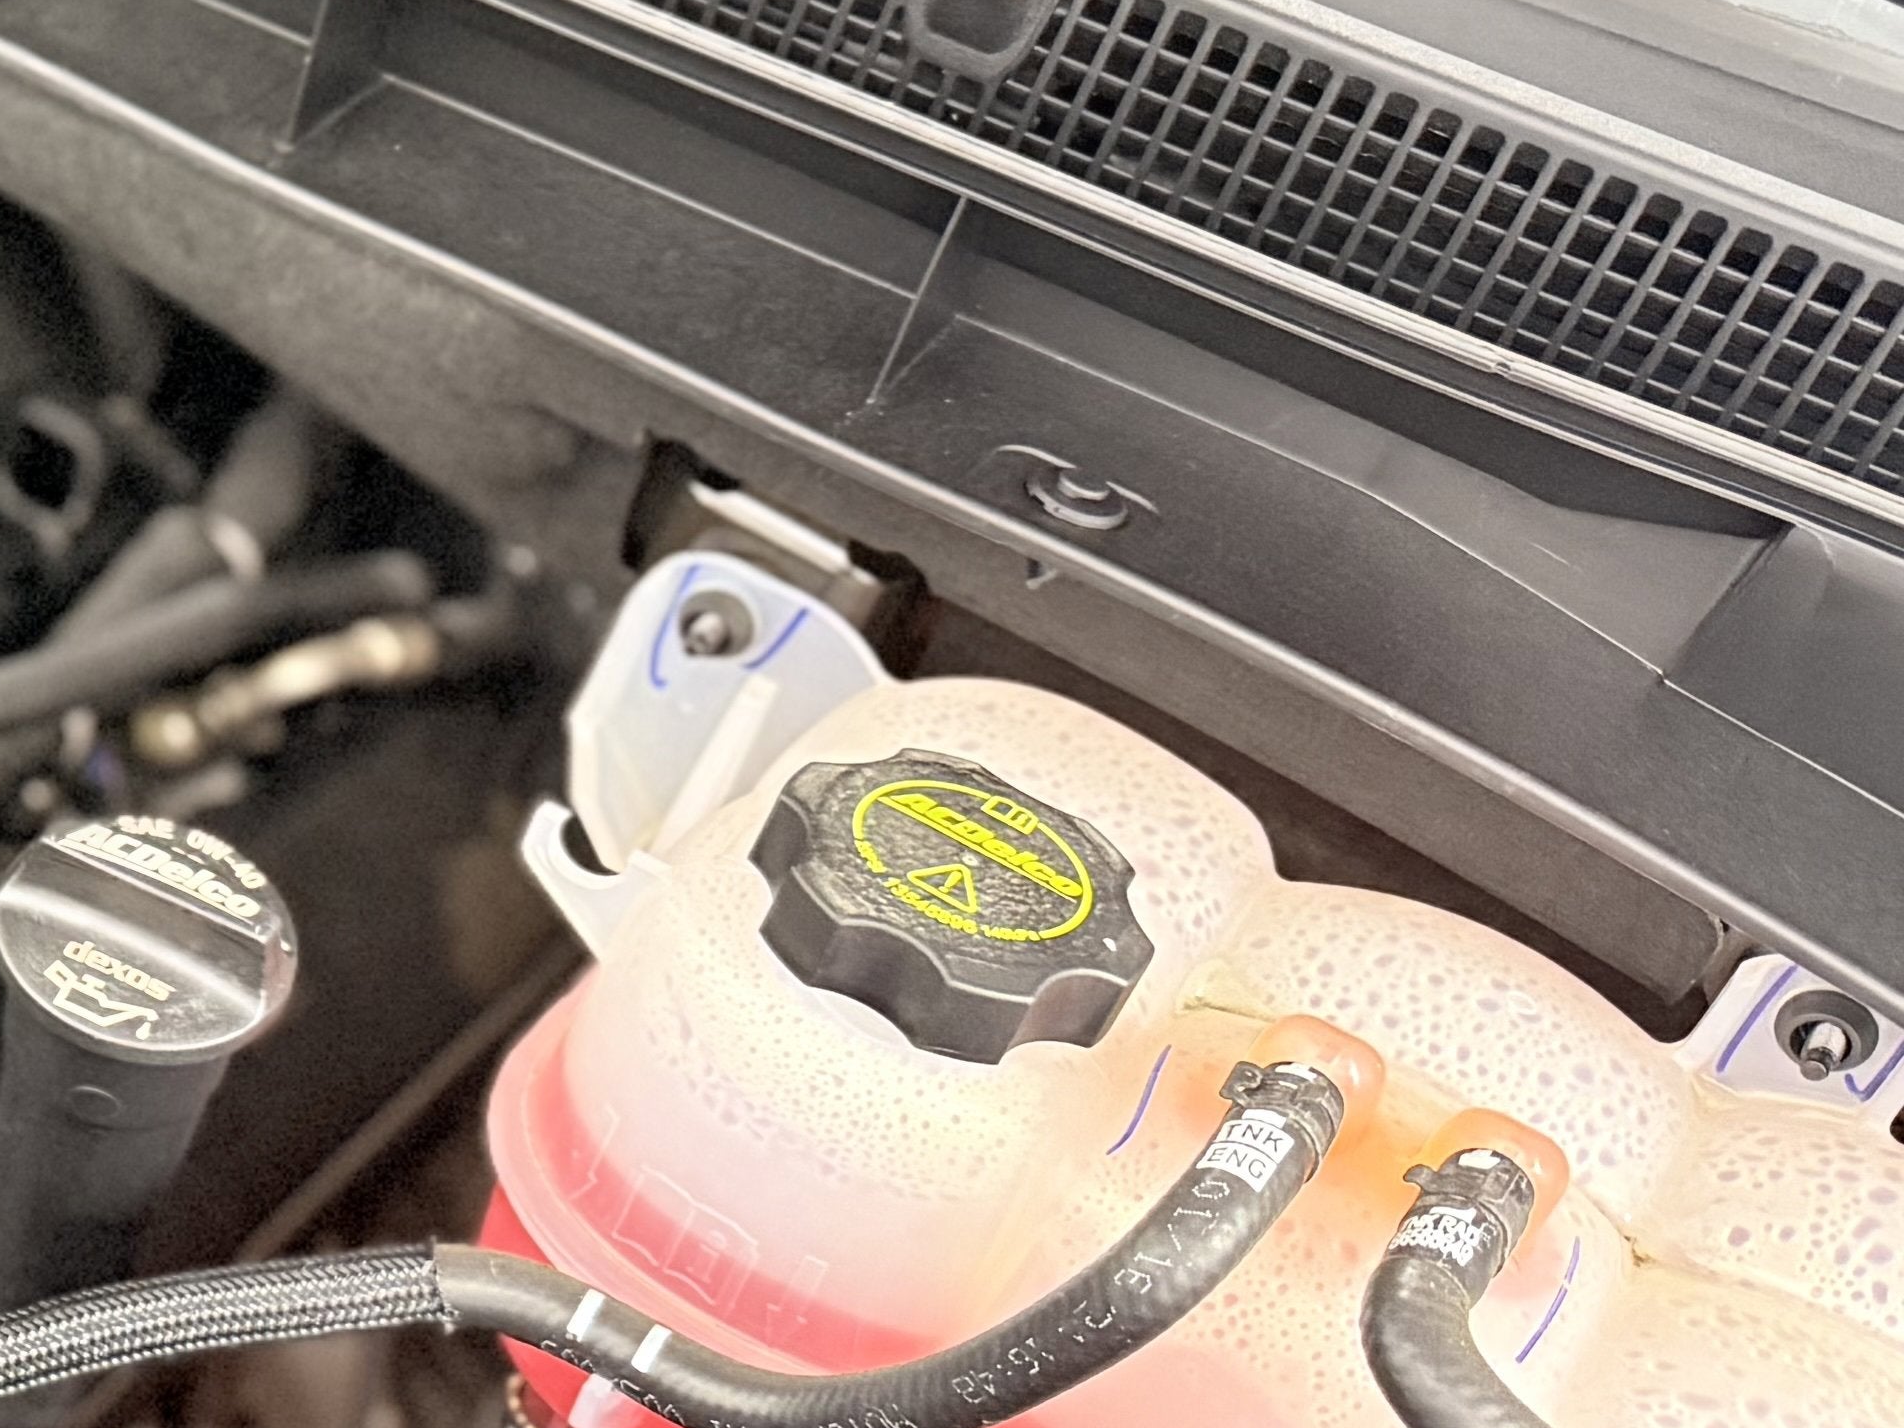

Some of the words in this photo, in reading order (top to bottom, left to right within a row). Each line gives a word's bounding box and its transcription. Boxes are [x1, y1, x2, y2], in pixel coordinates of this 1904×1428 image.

[65, 823, 262, 918] ACDelco
[116, 814, 176, 840] SAE
[185, 828, 268, 890] 0W-40
[888, 793, 1084, 898] ACDelco
[62, 939, 177, 1002] dexos
[1206, 1146, 1267, 1180] ENG
